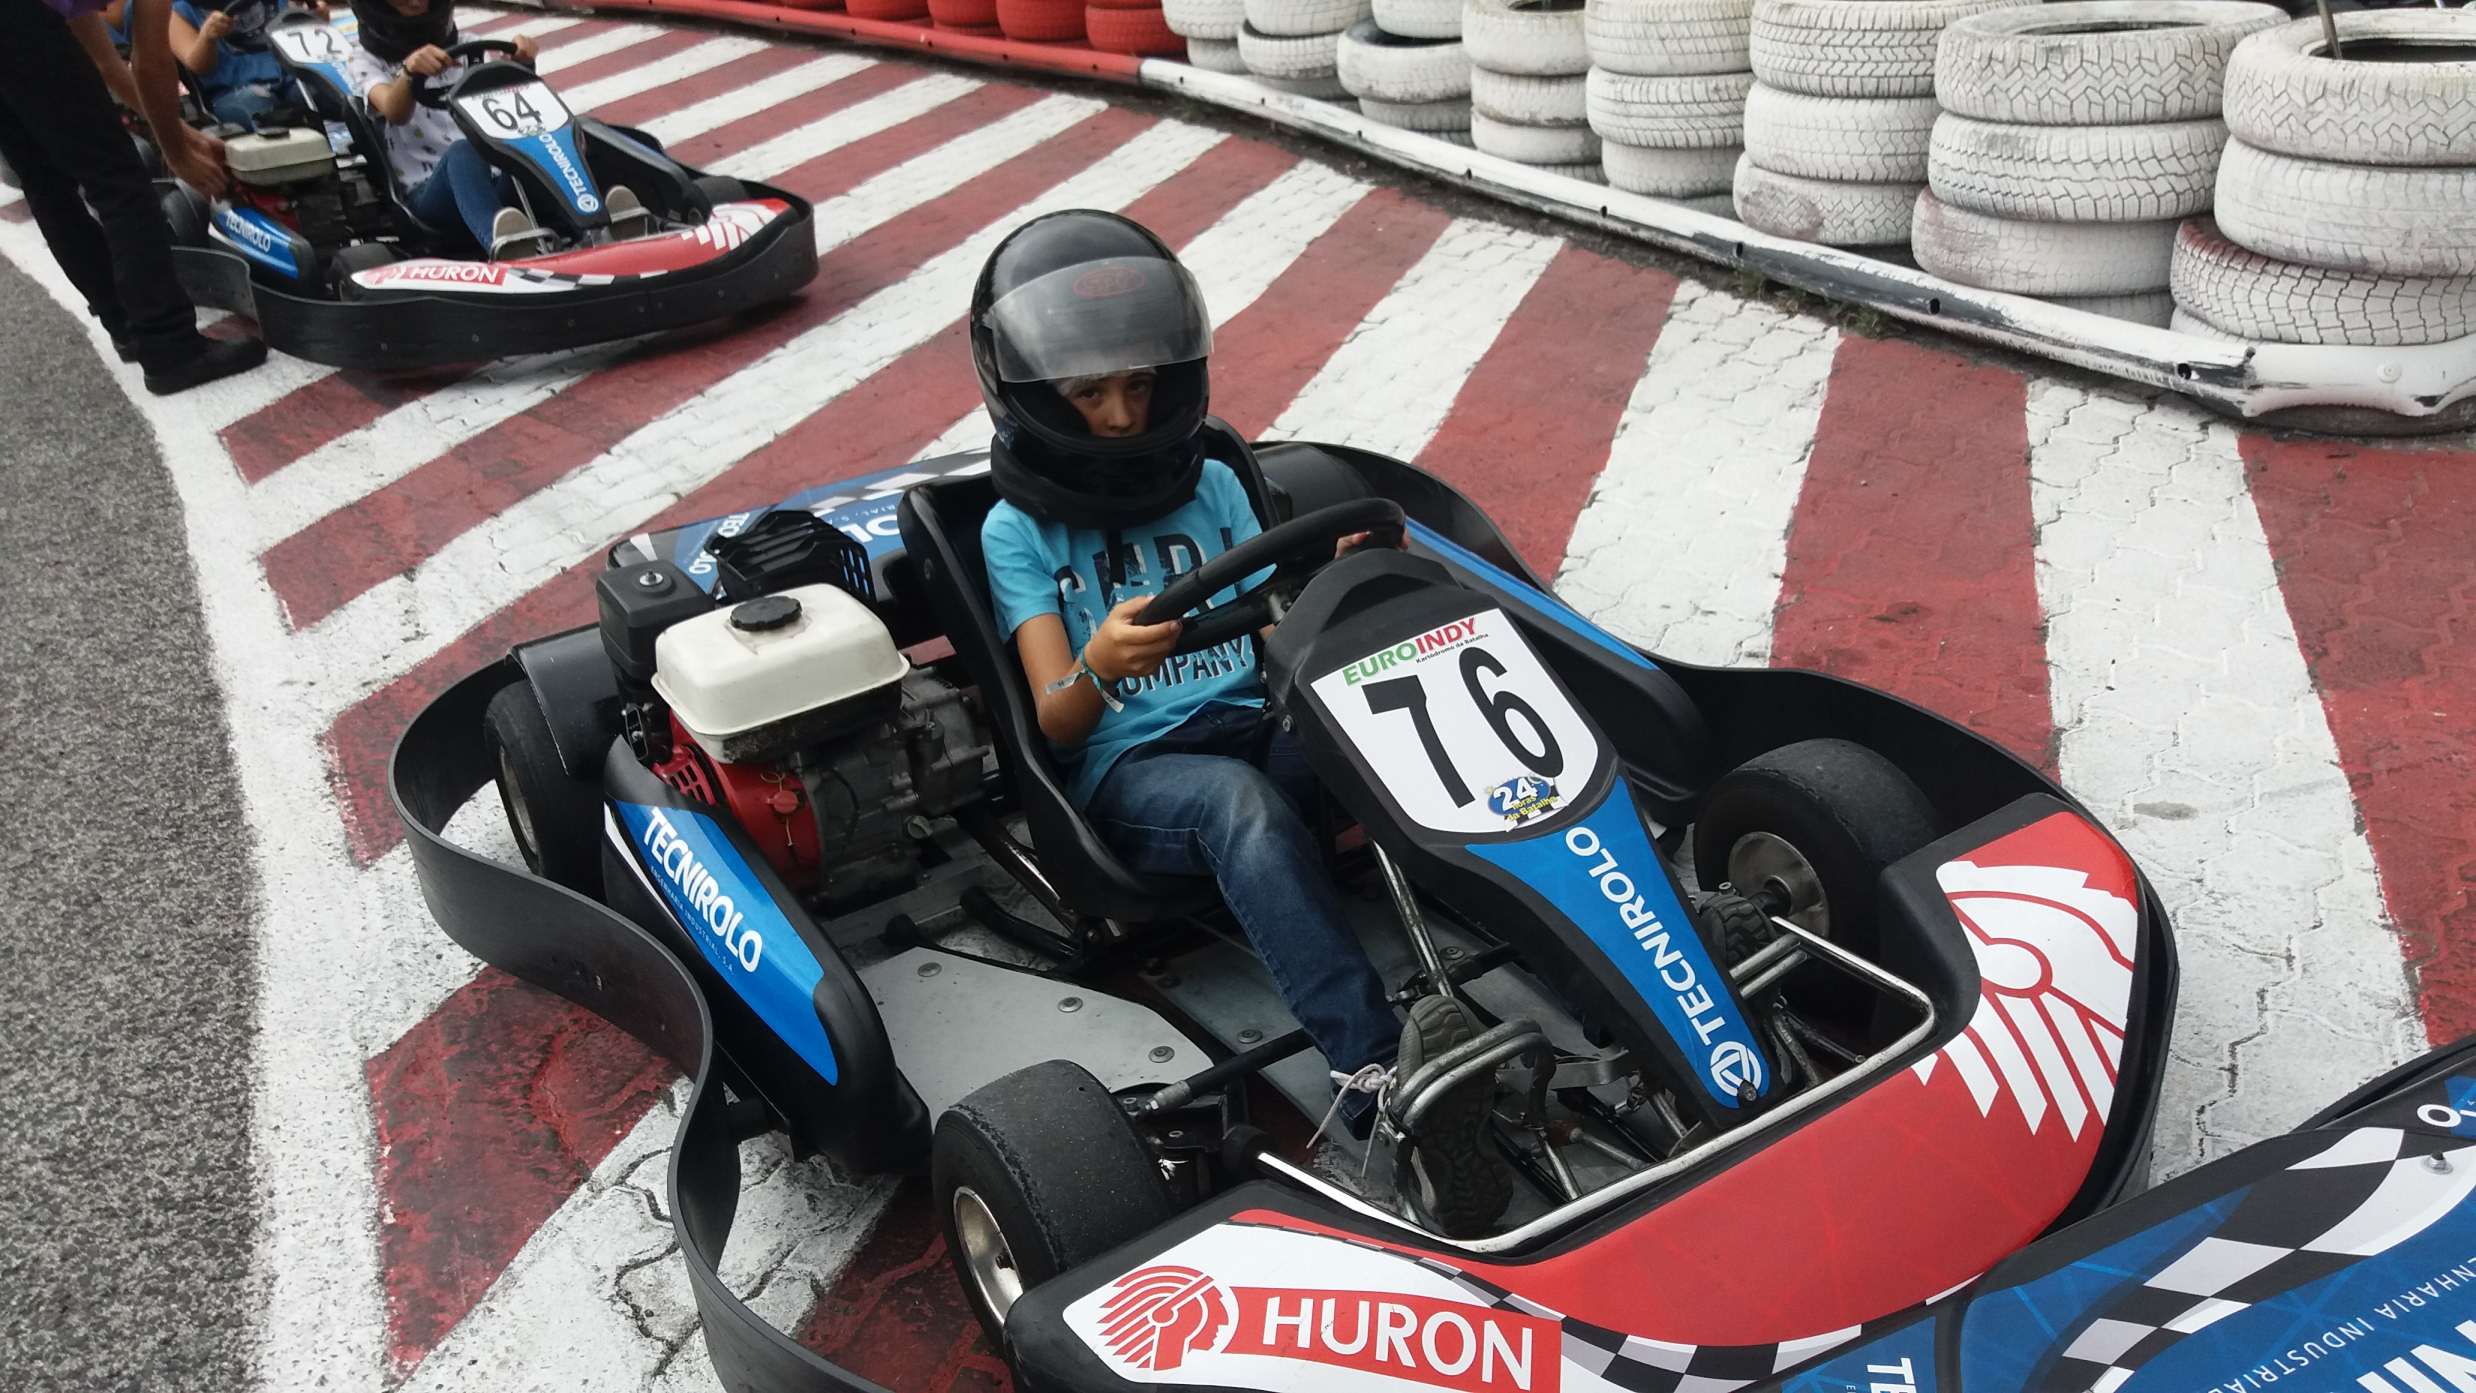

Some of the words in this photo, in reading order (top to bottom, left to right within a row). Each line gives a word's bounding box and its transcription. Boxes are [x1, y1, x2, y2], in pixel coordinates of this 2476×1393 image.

[287, 29, 342, 56] 72
[482, 92, 542, 130] 64
[538, 133, 587, 196] TECNIROLO
[410, 265, 498, 283] HURON
[1114, 633, 1250, 697] OMPANY
[1343, 616, 1475, 686] EUROINDY
[1361, 646, 1564, 809] 76
[1493, 777, 1538, 812] 24
[643, 806, 763, 973] TECNIROLO
[1565, 826, 1725, 1046] TECNIROLO
[1262, 1296, 1533, 1390] HURON
